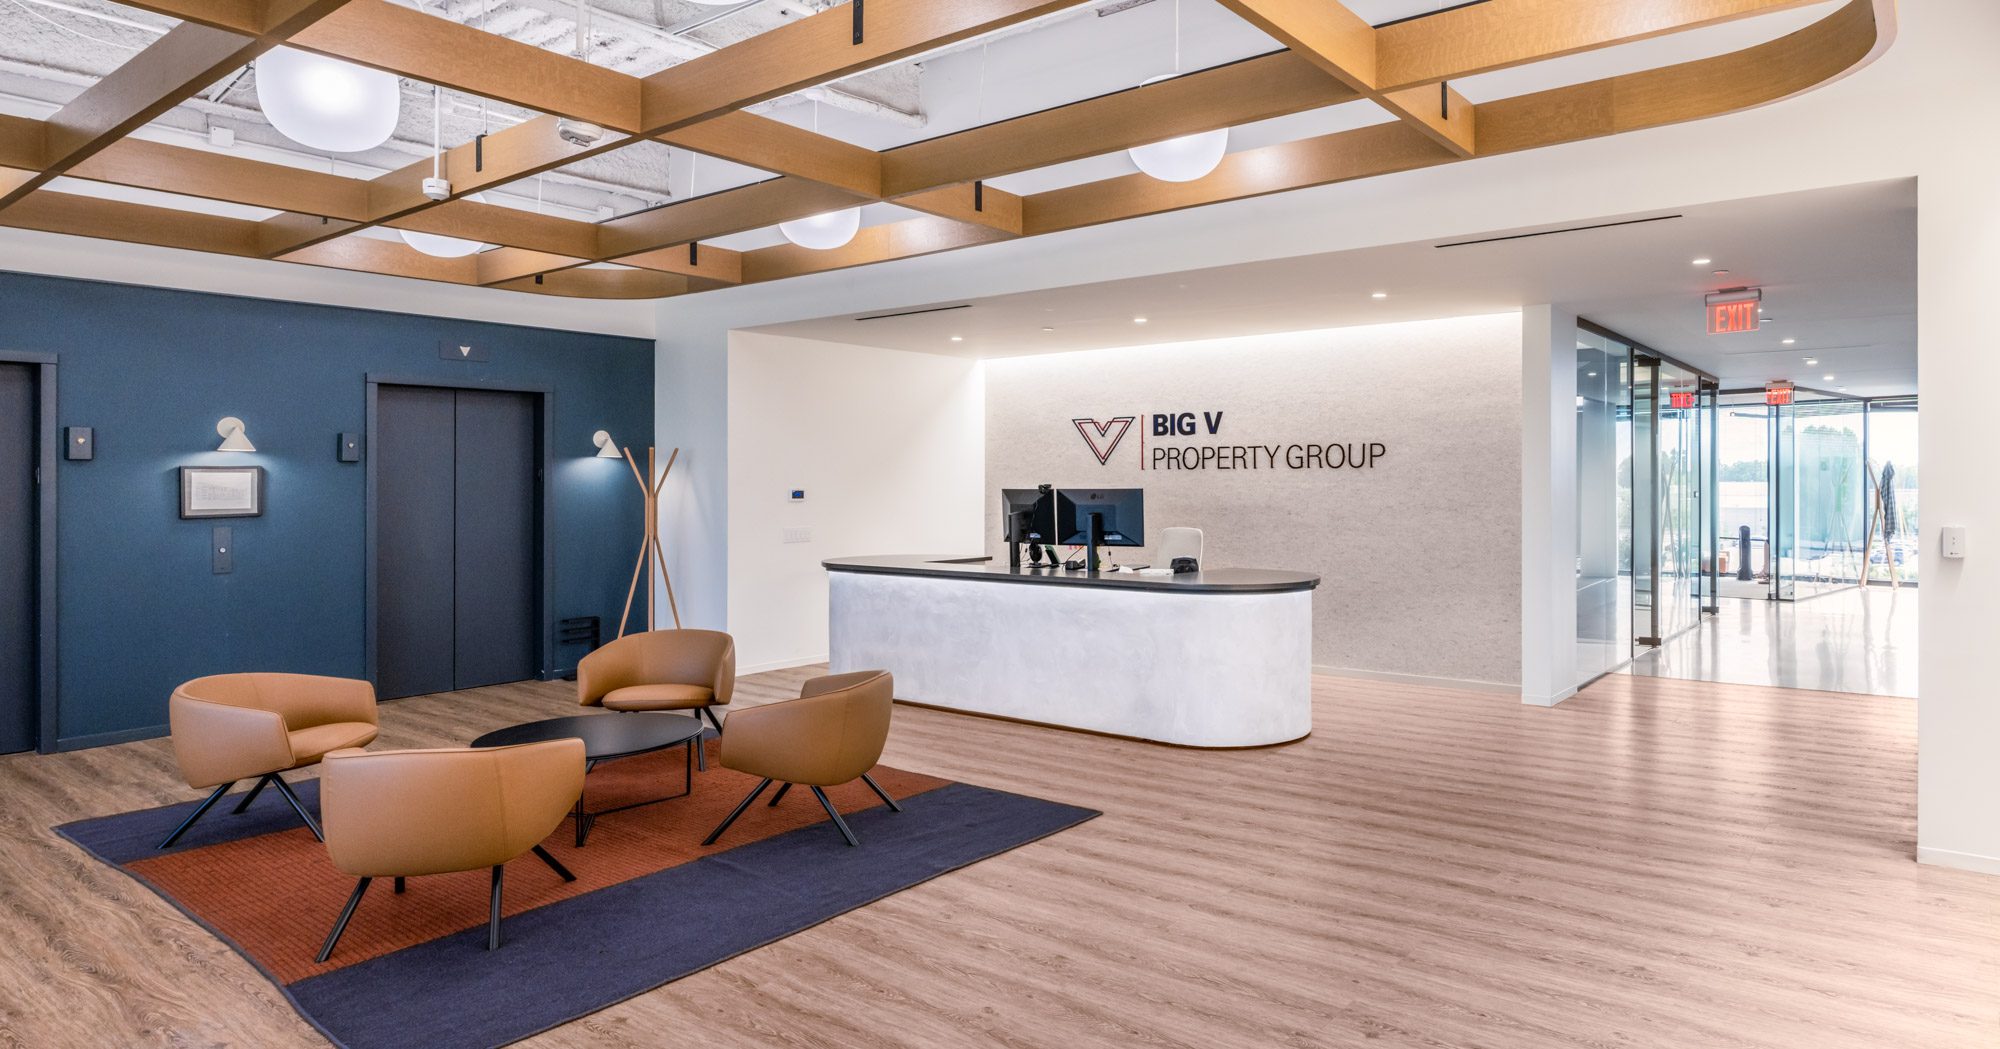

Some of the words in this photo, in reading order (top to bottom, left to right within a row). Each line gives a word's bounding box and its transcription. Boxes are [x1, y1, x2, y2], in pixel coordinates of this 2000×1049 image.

[1716, 303, 1754, 332] EXIT
[1771, 388, 1791, 404] EXIT
[1153, 413, 1196, 436] BIG
[1204, 411, 1223, 435] V
[1153, 445, 1281, 470] PROPERTY
[1286, 443, 1386, 469] GROUP
